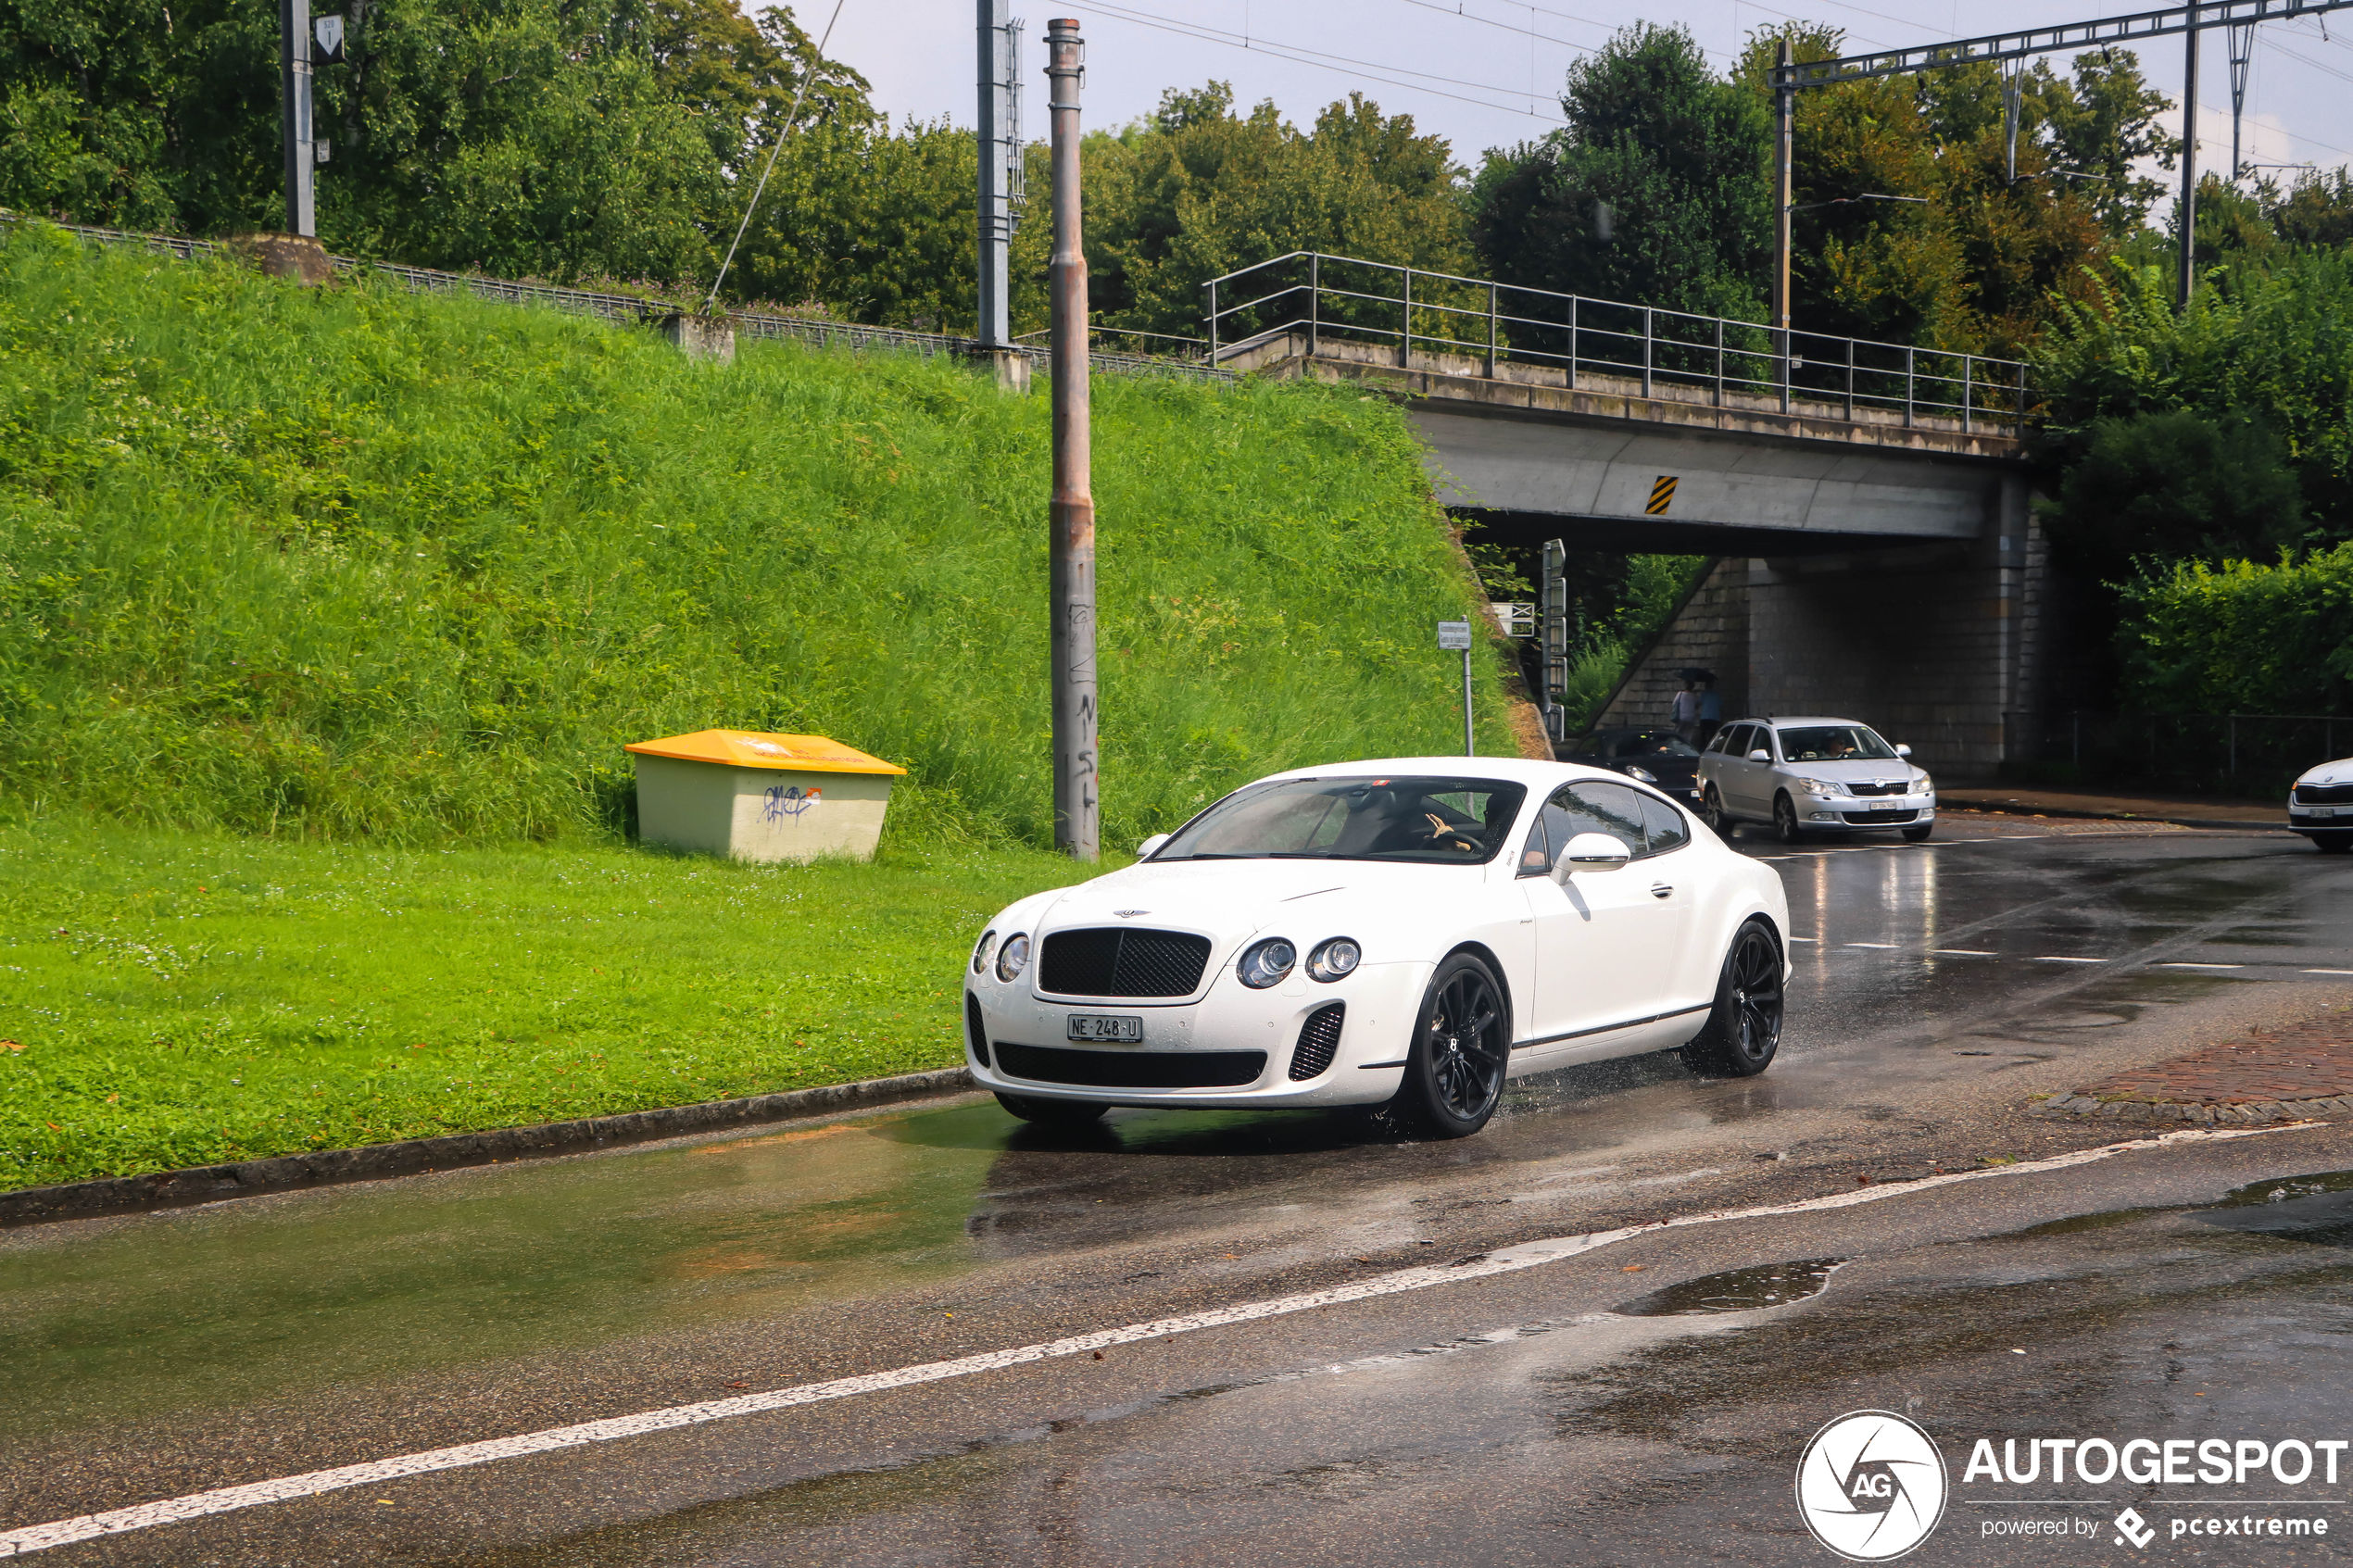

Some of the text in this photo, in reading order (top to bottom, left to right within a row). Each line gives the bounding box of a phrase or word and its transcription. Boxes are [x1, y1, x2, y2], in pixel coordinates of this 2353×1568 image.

[1072, 1018, 1138, 1036] NE 248 U
